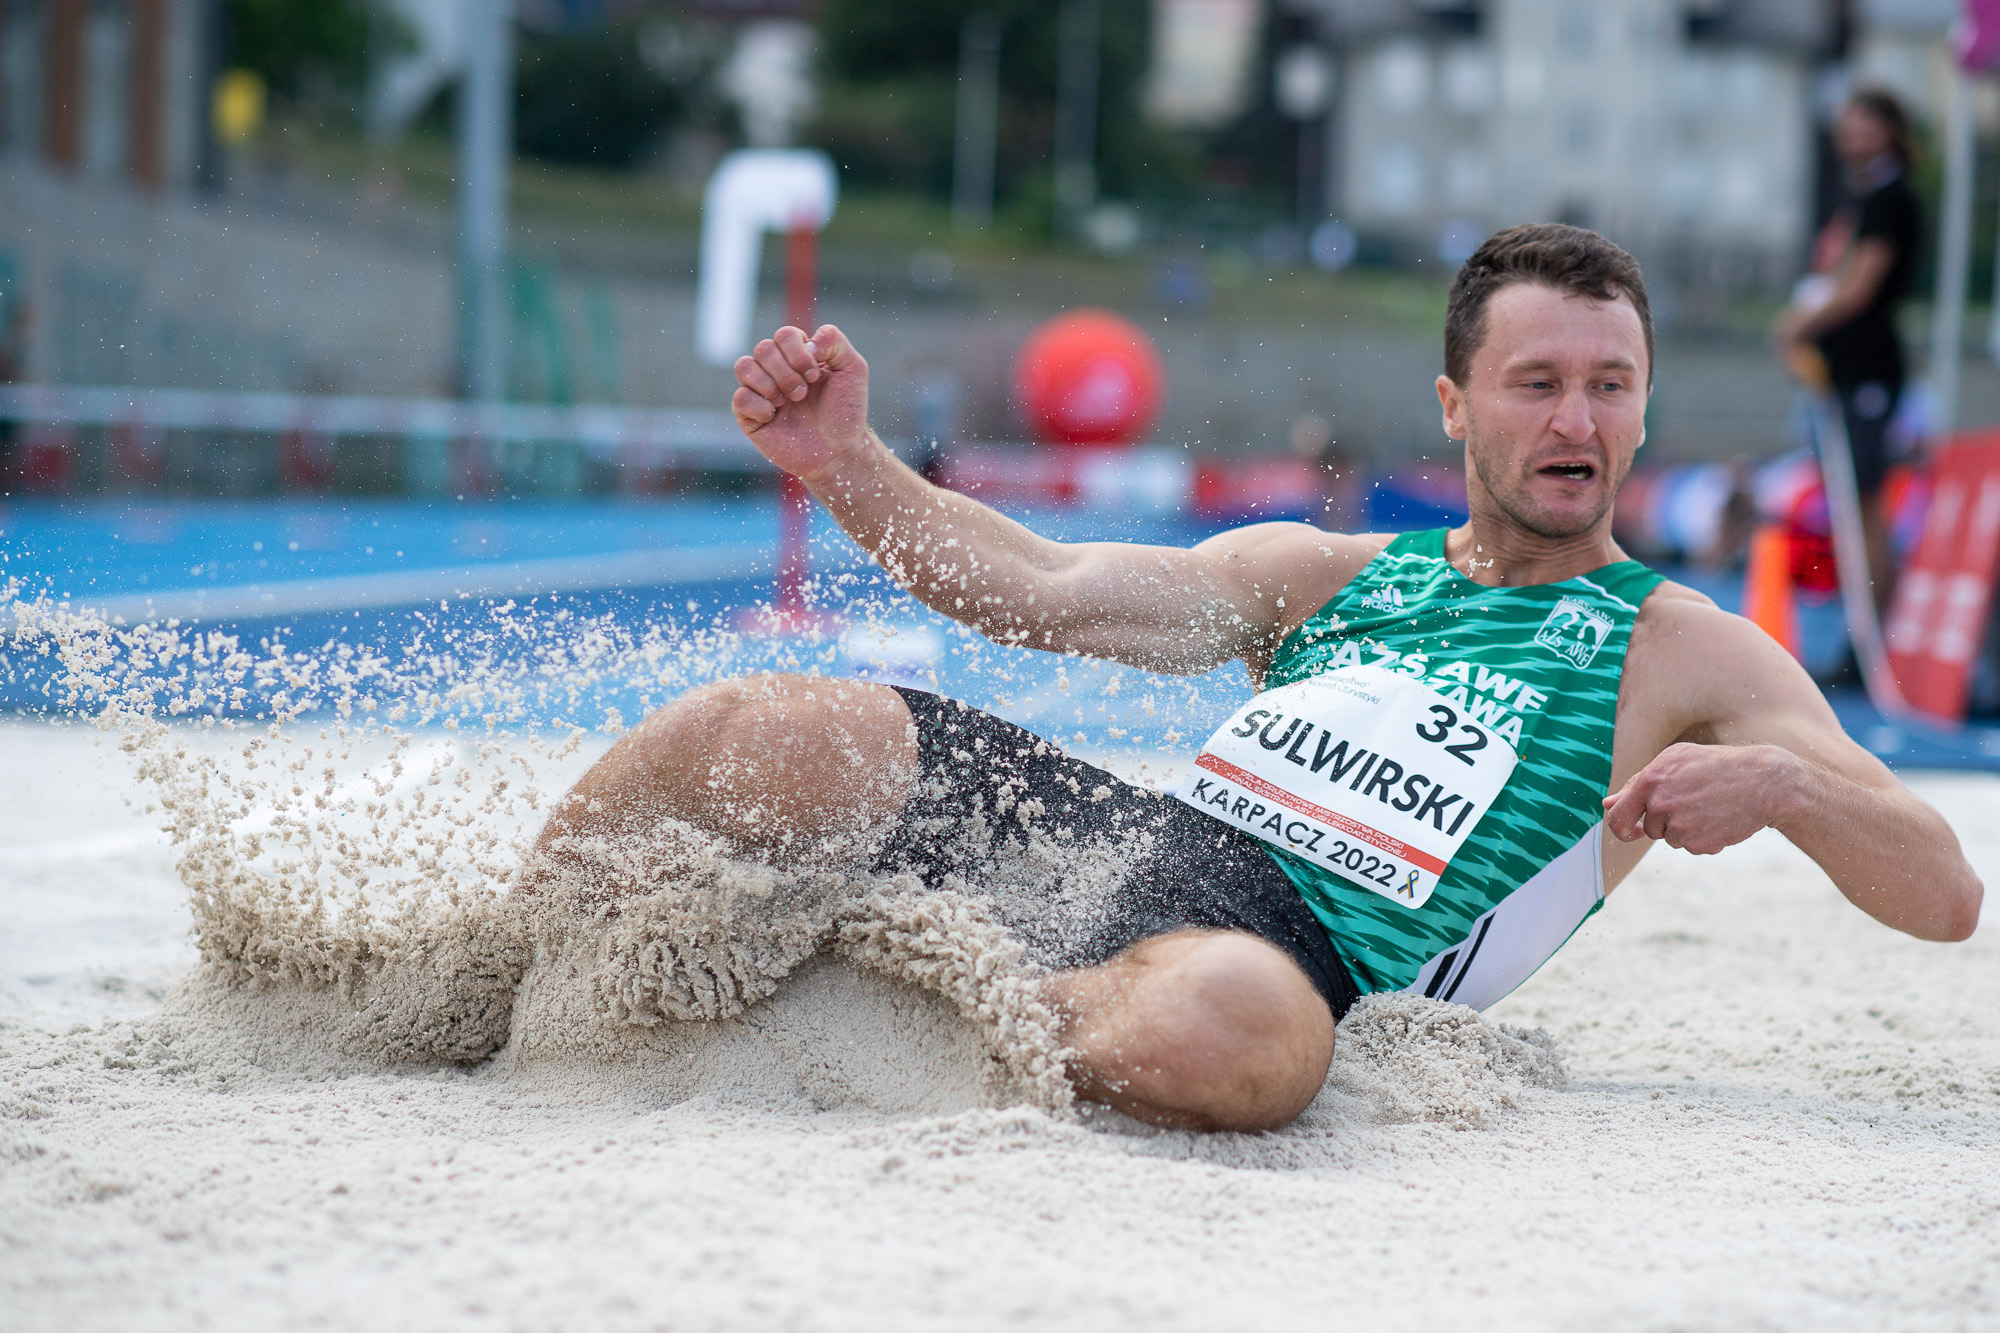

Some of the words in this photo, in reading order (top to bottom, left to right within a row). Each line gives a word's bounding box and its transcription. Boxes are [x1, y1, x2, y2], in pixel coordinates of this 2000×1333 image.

[1362, 597, 1406, 614] adidas
[1562, 595, 1614, 626] WARSZAWA
[1331, 640, 1429, 679] AZS
[1434, 661, 1548, 712] AWF
[1538, 628, 1564, 647] AZS
[1565, 641, 1590, 665] AWF
[1416, 704, 1488, 767] 32
[1231, 710, 1475, 837] SULWIRSKI
[1191, 777, 1326, 853] KARPACZ
[1326, 841, 1397, 887] 2022
[1255, 786, 1311, 815] EKSTRAKLASY
[1311, 811, 1327, 821] LIGI
[1327, 818, 1408, 858] LEKKOATLETYCZNEJ
[1316, 806, 1374, 836] MISTRZOSTWA
[1374, 832, 1405, 849] POLSKI
